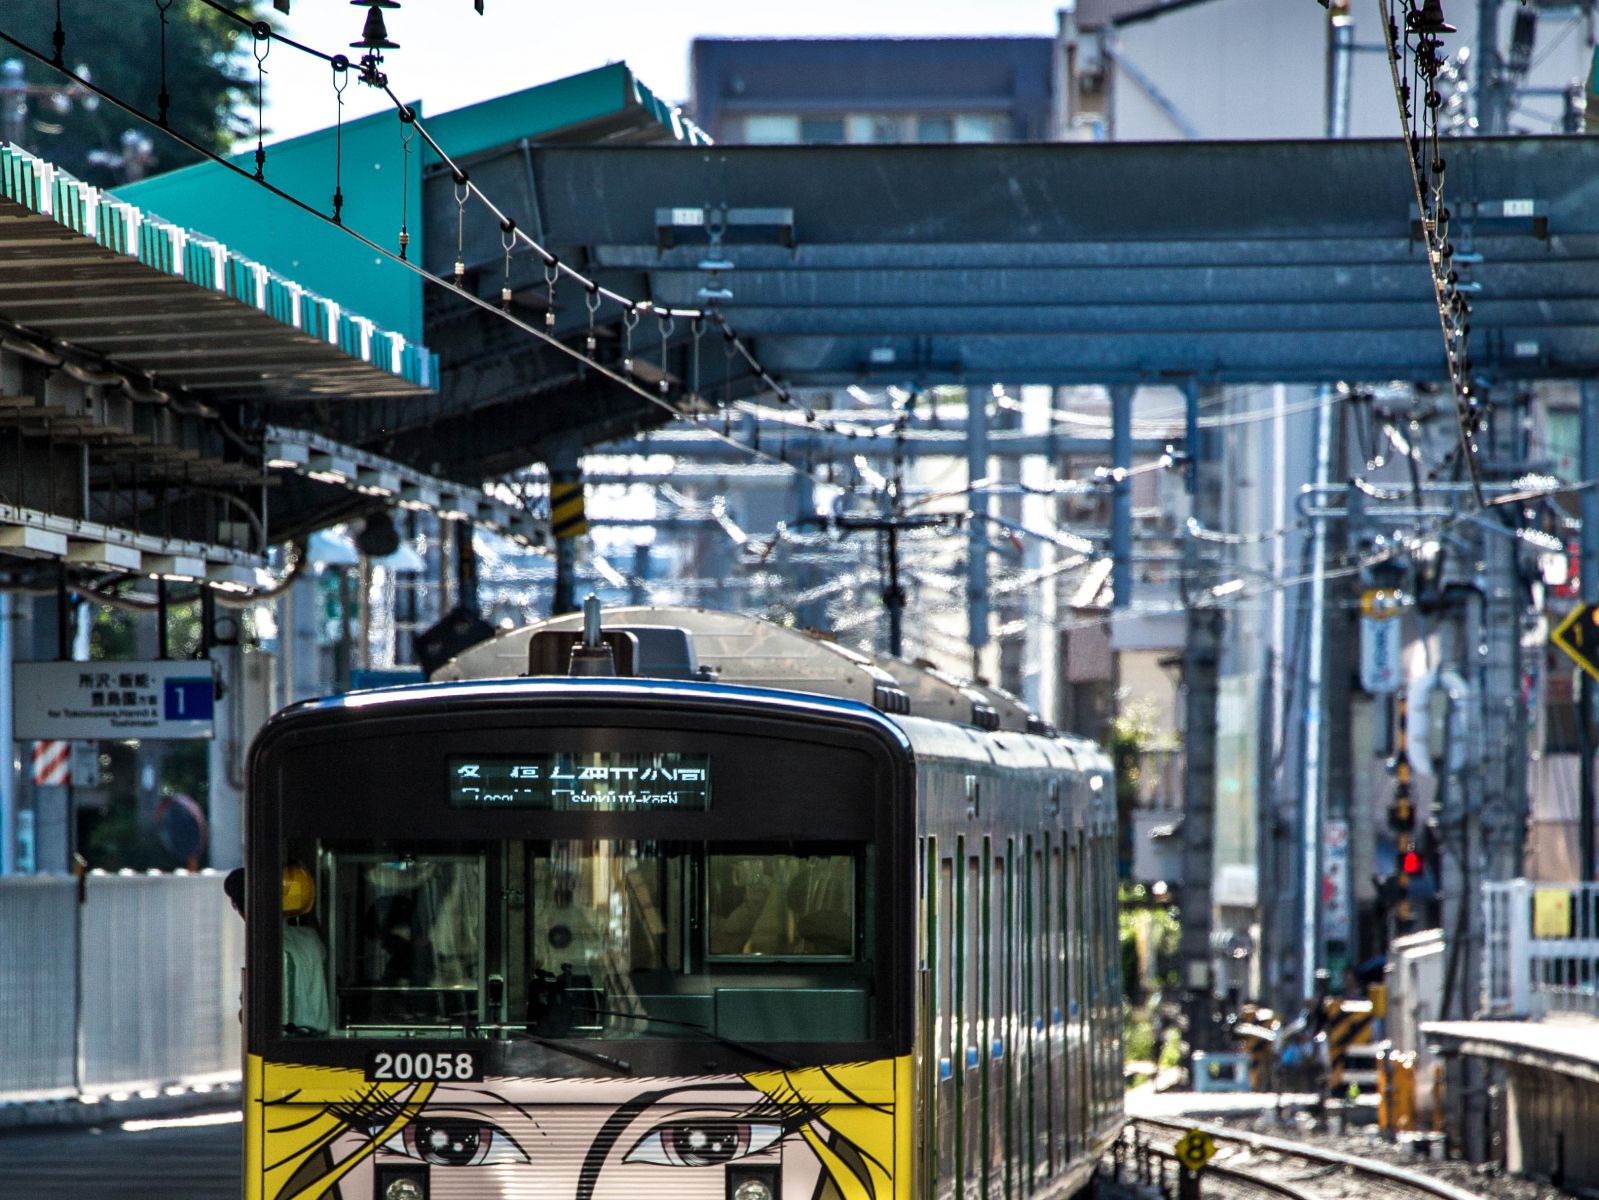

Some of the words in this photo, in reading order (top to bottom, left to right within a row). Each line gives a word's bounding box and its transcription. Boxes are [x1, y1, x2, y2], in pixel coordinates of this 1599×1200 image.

[175, 687, 185, 715] 1
[374, 1053, 474, 1079] 20058
[1186, 1136, 1206, 1162] 8
